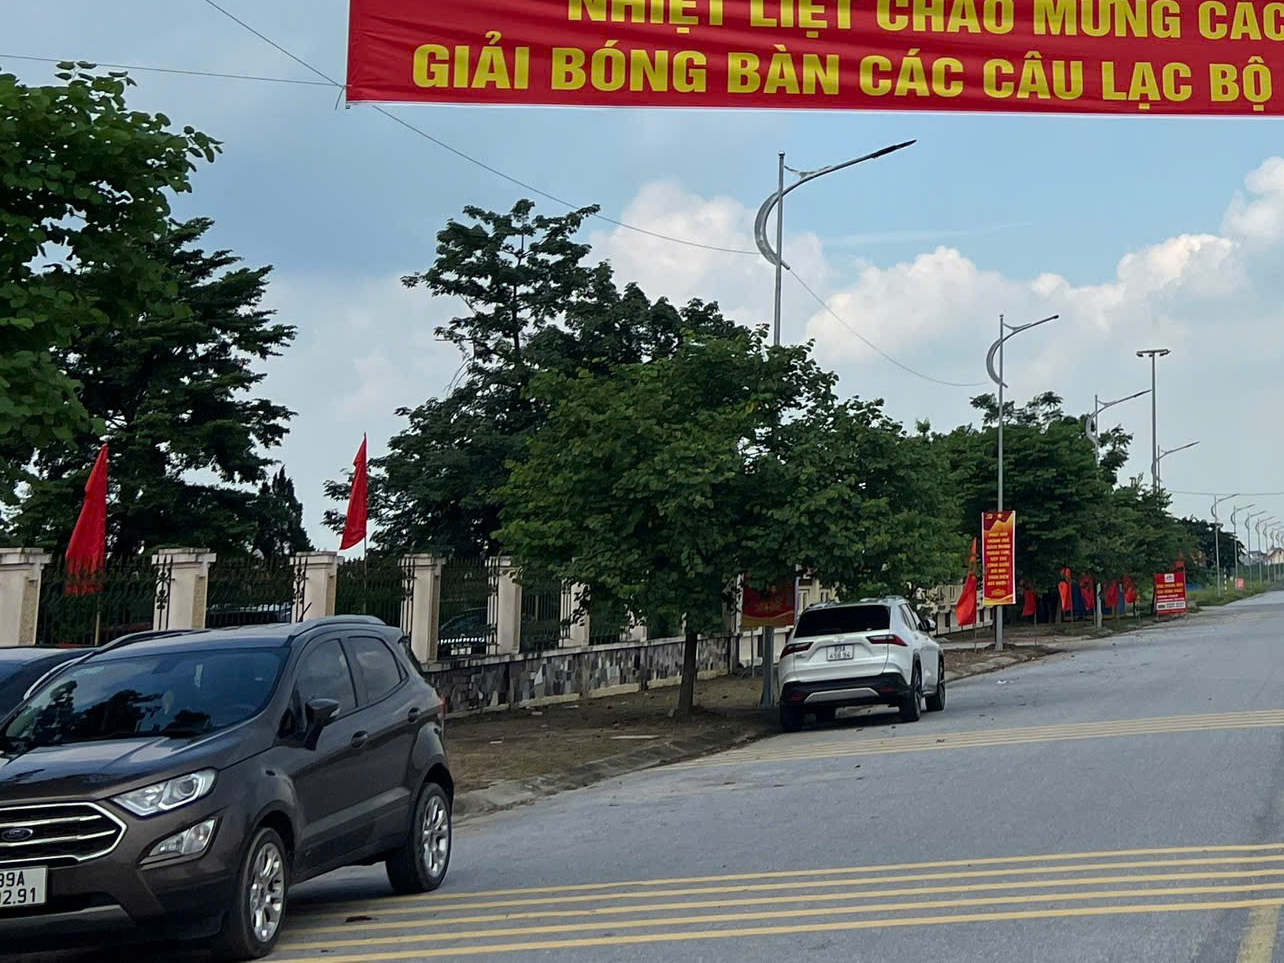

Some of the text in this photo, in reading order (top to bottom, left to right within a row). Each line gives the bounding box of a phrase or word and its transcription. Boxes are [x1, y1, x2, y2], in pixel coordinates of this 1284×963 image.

[413, 31, 530, 90] GIẢI
[552, 40, 707, 93] BÓNG
[728, 45, 840, 95] BÀN
[860, 49, 964, 98] CÁC
[984, 52, 1084, 101] CÂU
[1102, 62, 1193, 110] LẠC
[1210, 56, 1273, 112] BỘ
[0, 887, 36, 905] 2.91
